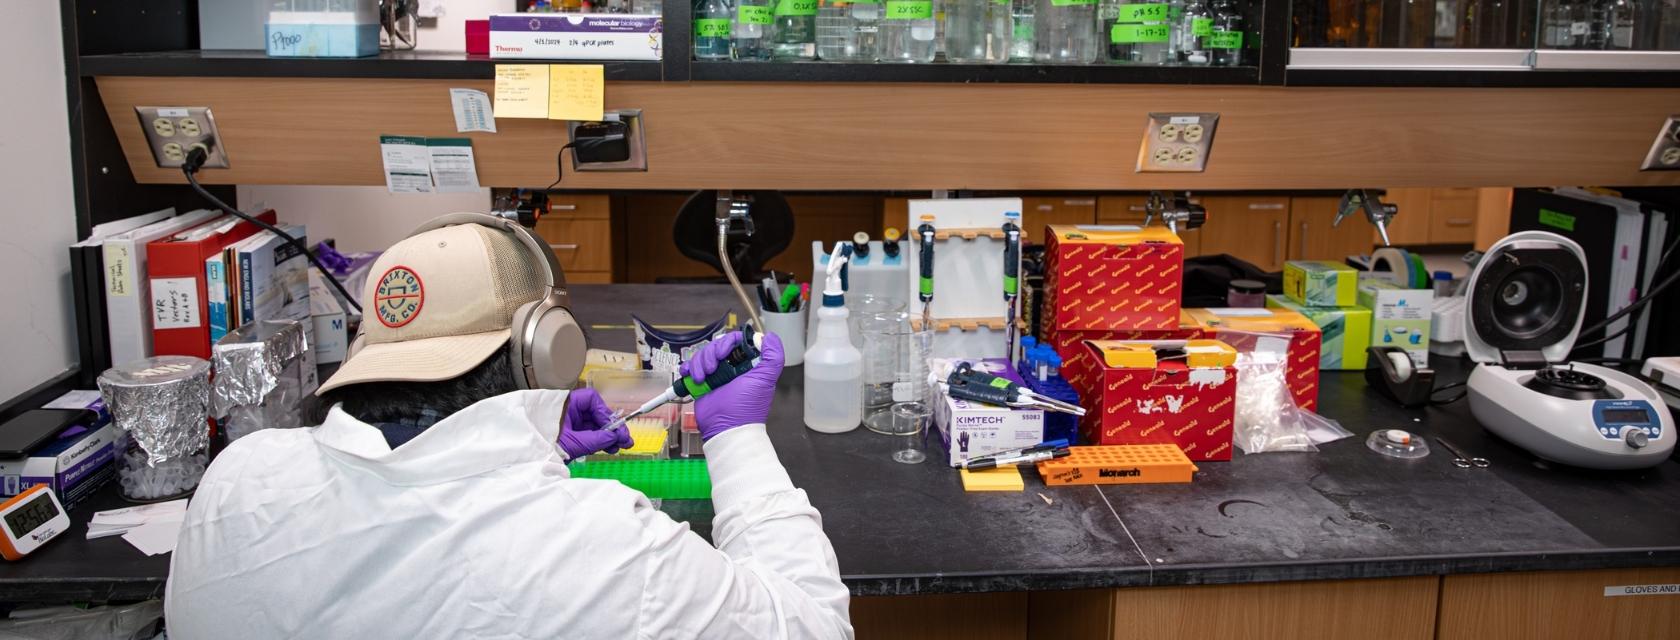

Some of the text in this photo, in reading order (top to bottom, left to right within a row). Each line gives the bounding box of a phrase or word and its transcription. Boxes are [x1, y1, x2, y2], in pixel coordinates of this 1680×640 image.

[379, 270, 419, 294] BRIXTON
[380, 302, 418, 323] MFG. CO.
[956, 416, 1004, 424] KIMTECH
[1624, 585, 1658, 594] GLOVES
[1659, 585, 1677, 593] AND
